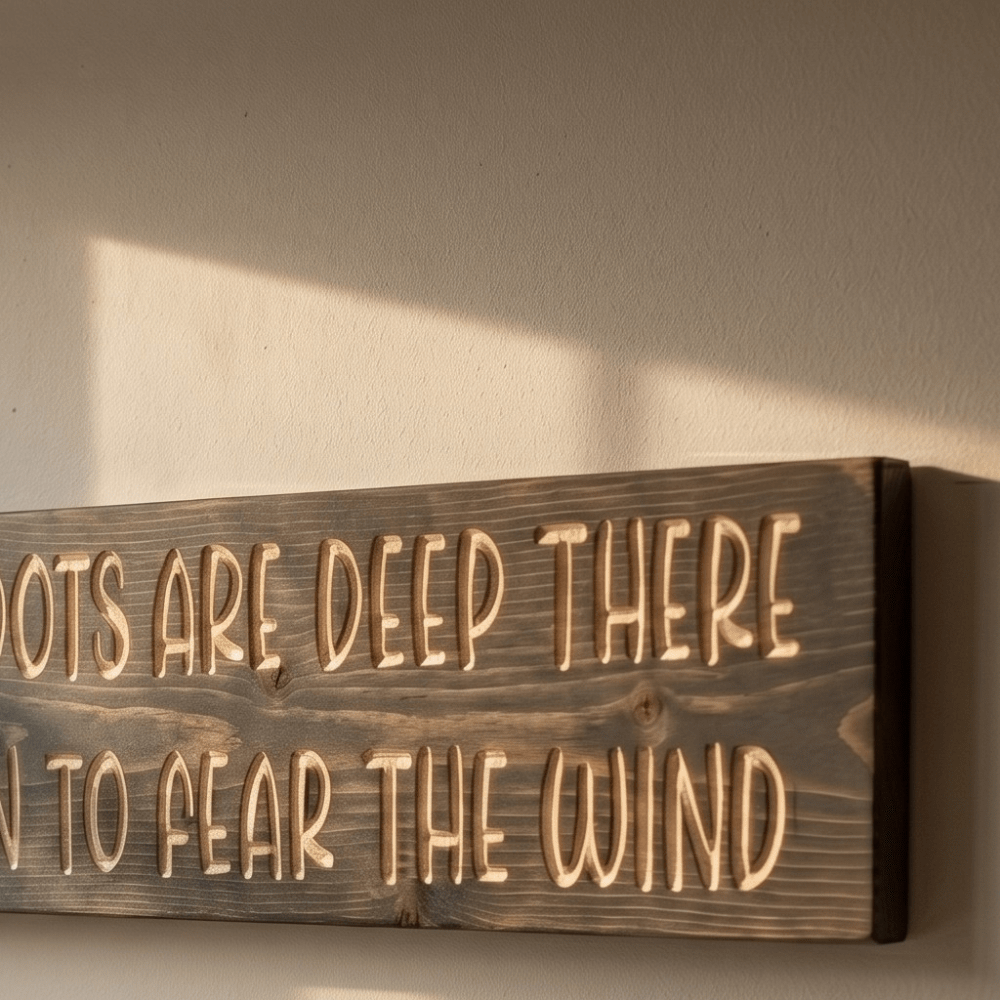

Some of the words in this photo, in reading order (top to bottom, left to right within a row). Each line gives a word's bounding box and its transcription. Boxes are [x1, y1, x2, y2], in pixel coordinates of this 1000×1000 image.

[152, 543, 281, 679] ARE
[316, 528, 505, 671] DEEP
[533, 512, 800, 671] THERE
[45, 749, 128, 876] TO
[157, 750, 335, 880] FEAR
[362, 745, 508, 885] THE
[539, 742, 786, 893] WIND
